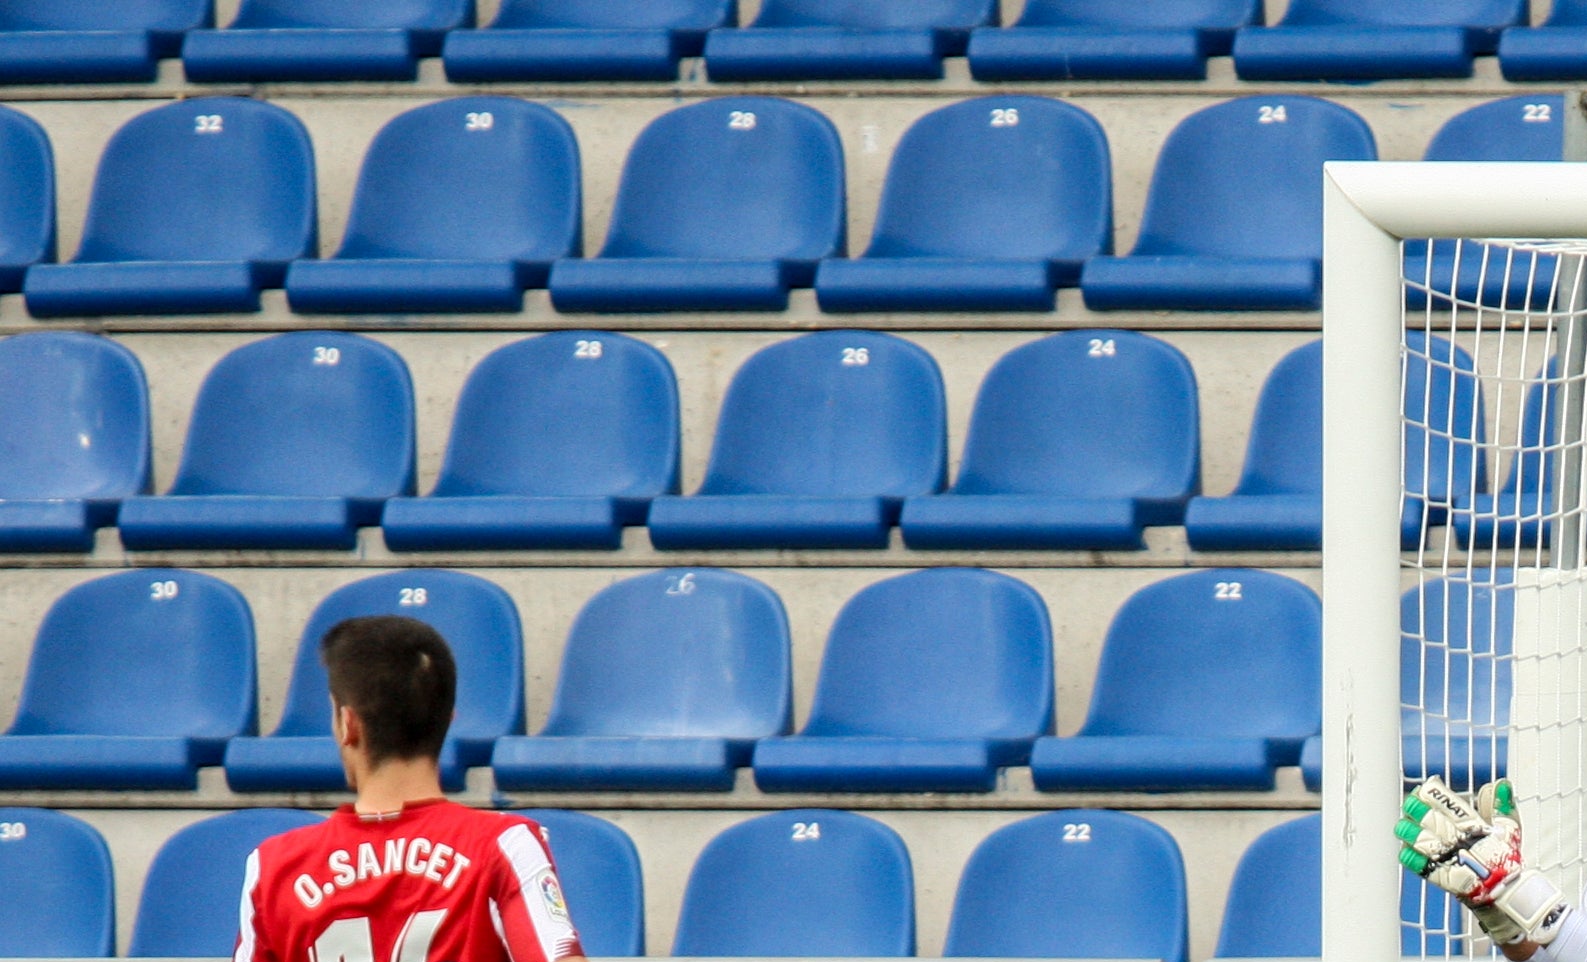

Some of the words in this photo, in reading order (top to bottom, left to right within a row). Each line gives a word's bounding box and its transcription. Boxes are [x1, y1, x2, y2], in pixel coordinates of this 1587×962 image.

[466, 112, 493, 131] 30
[729, 111, 756, 130] 28
[990, 108, 1018, 127] 26
[1258, 106, 1286, 124] 24
[1523, 104, 1551, 122] 22
[195, 115, 223, 133] 32
[314, 346, 340, 365] 30
[574, 340, 602, 358] 28
[842, 348, 869, 366] 26
[1088, 339, 1116, 357] 24
[151, 581, 178, 600] 30
[399, 588, 427, 606] 28
[1215, 582, 1242, 599] 22
[1427, 788, 1469, 818] RINAT
[0, 823, 26, 841] 30
[792, 823, 820, 840] 24
[1063, 824, 1091, 842] 22
[294, 837, 470, 908] O.SANCET
